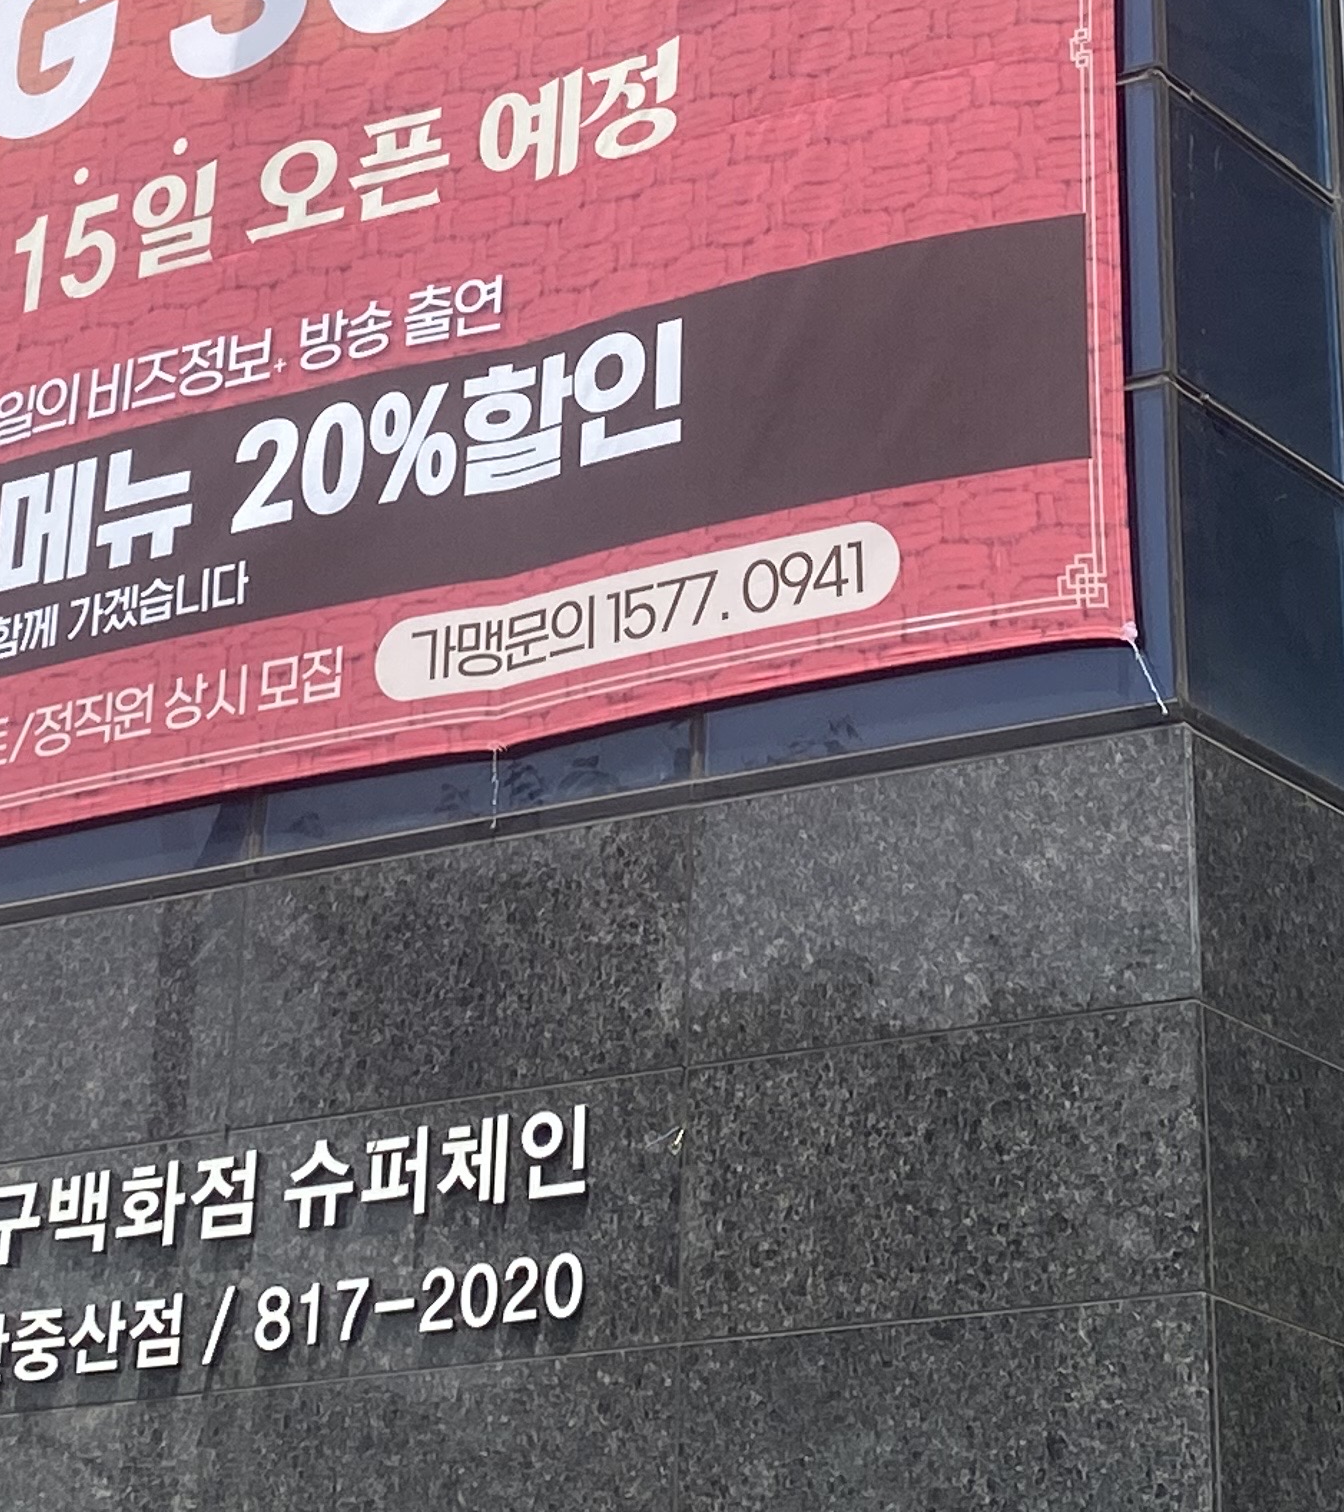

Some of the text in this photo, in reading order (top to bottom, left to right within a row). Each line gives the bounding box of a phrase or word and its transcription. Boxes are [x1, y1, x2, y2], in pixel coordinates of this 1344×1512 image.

[245, 108, 450, 242] 오픈
[478, 36, 680, 181] 예정
[299, 305, 393, 371] 방송
[404, 275, 505, 346] 출연
[67, 561, 249, 643] 가겠습니다
[412, 595, 595, 680] 가맹문의
[164, 673, 247, 730] 상시
[258, 646, 344, 711] 모집
[283, 1104, 589, 1229] 슈퍼체인
[254, 1252, 584, 1350] 817-2020
